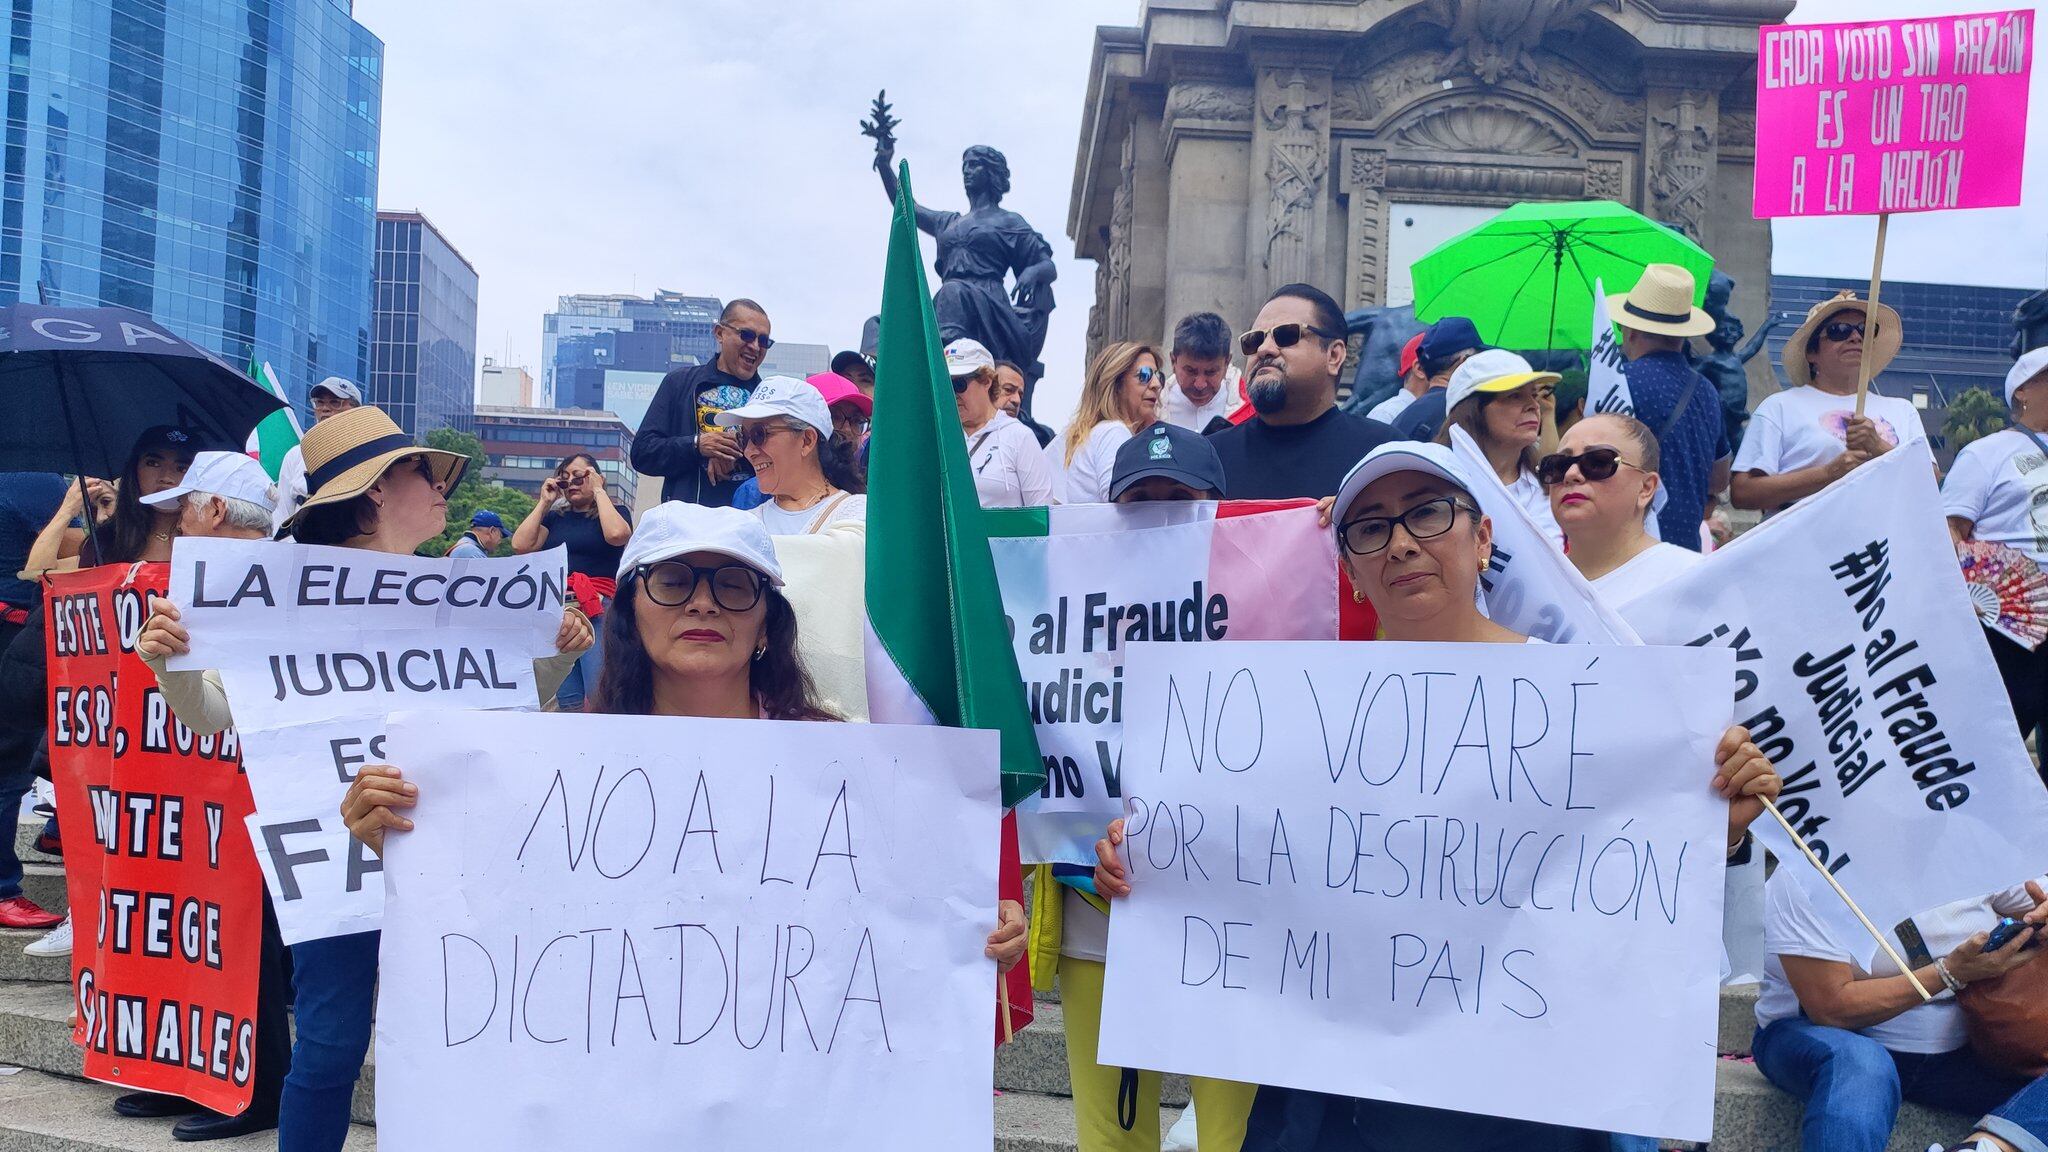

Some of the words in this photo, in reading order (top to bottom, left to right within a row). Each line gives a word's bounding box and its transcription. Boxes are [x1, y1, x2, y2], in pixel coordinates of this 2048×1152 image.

[1765, 29, 1824, 89] CADA
[1834, 26, 1893, 83] VOTO
[1900, 22, 1941, 78] SIN
[1952, 13, 2028, 76] RAZÓN
[1816, 90, 1848, 149] ES
[1870, 84, 1904, 146] UN
[1919, 83, 1968, 143] TIRO
[1790, 155, 1806, 214] A
[1824, 153, 1856, 213] LA
[1878, 149, 1965, 209] NACIÓN
[193, 560, 276, 608] LA
[297, 564, 564, 611] ELECCIÓN
[1029, 596, 1068, 654] al
[1082, 581, 1229, 653] Fraude
[1829, 537, 1892, 632] #No
[51, 592, 109, 658] ESTE
[1863, 628, 1919, 677] al
[269, 647, 517, 702] JUDICIAL
[1160, 667, 1264, 774] NO
[1304, 656, 1600, 811] VOTARÉ
[1792, 643, 1887, 799] Judicial
[1872, 663, 1976, 812] Fraude
[204, 801, 224, 870] Y
[517, 765, 657, 880] NO
[672, 770, 724, 874] A
[760, 775, 862, 894] LA
[1124, 796, 1210, 883] POR
[1236, 804, 1297, 885] LA
[1326, 805, 1688, 924] DESTRUCCIÓN
[440, 923, 893, 1055] DICTADURA
[1180, 915, 1254, 990] DE
[1280, 928, 1331, 1000] MI
[1390, 934, 1548, 1019] PAIS
